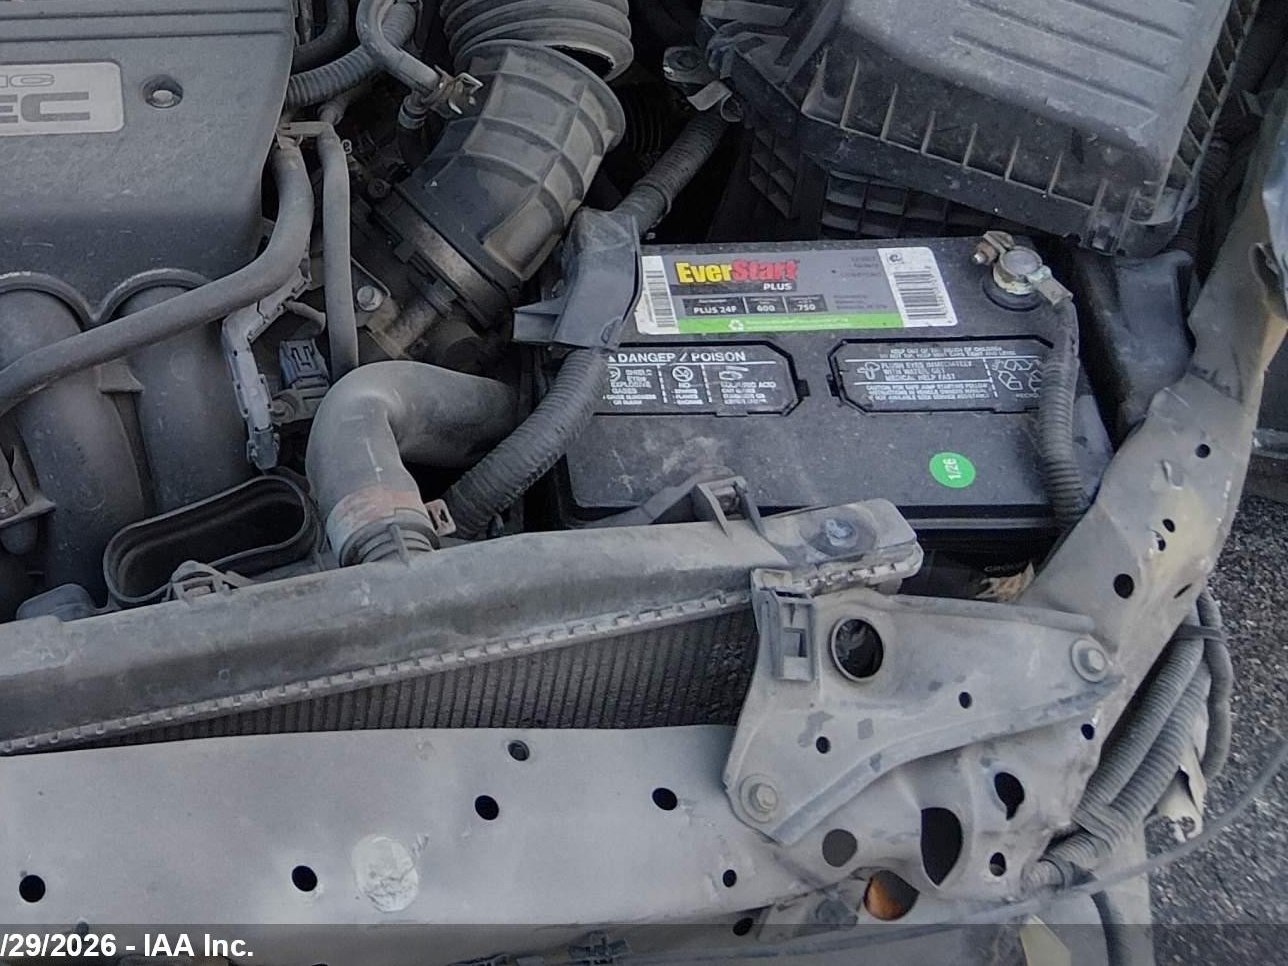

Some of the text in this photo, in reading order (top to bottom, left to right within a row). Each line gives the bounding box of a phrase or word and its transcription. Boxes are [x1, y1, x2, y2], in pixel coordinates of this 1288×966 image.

[674, 258, 800, 285] EverStart
[763, 282, 792, 291] PLUS
[693, 306, 718, 314] PLUS
[691, 351, 746, 362] POISON
